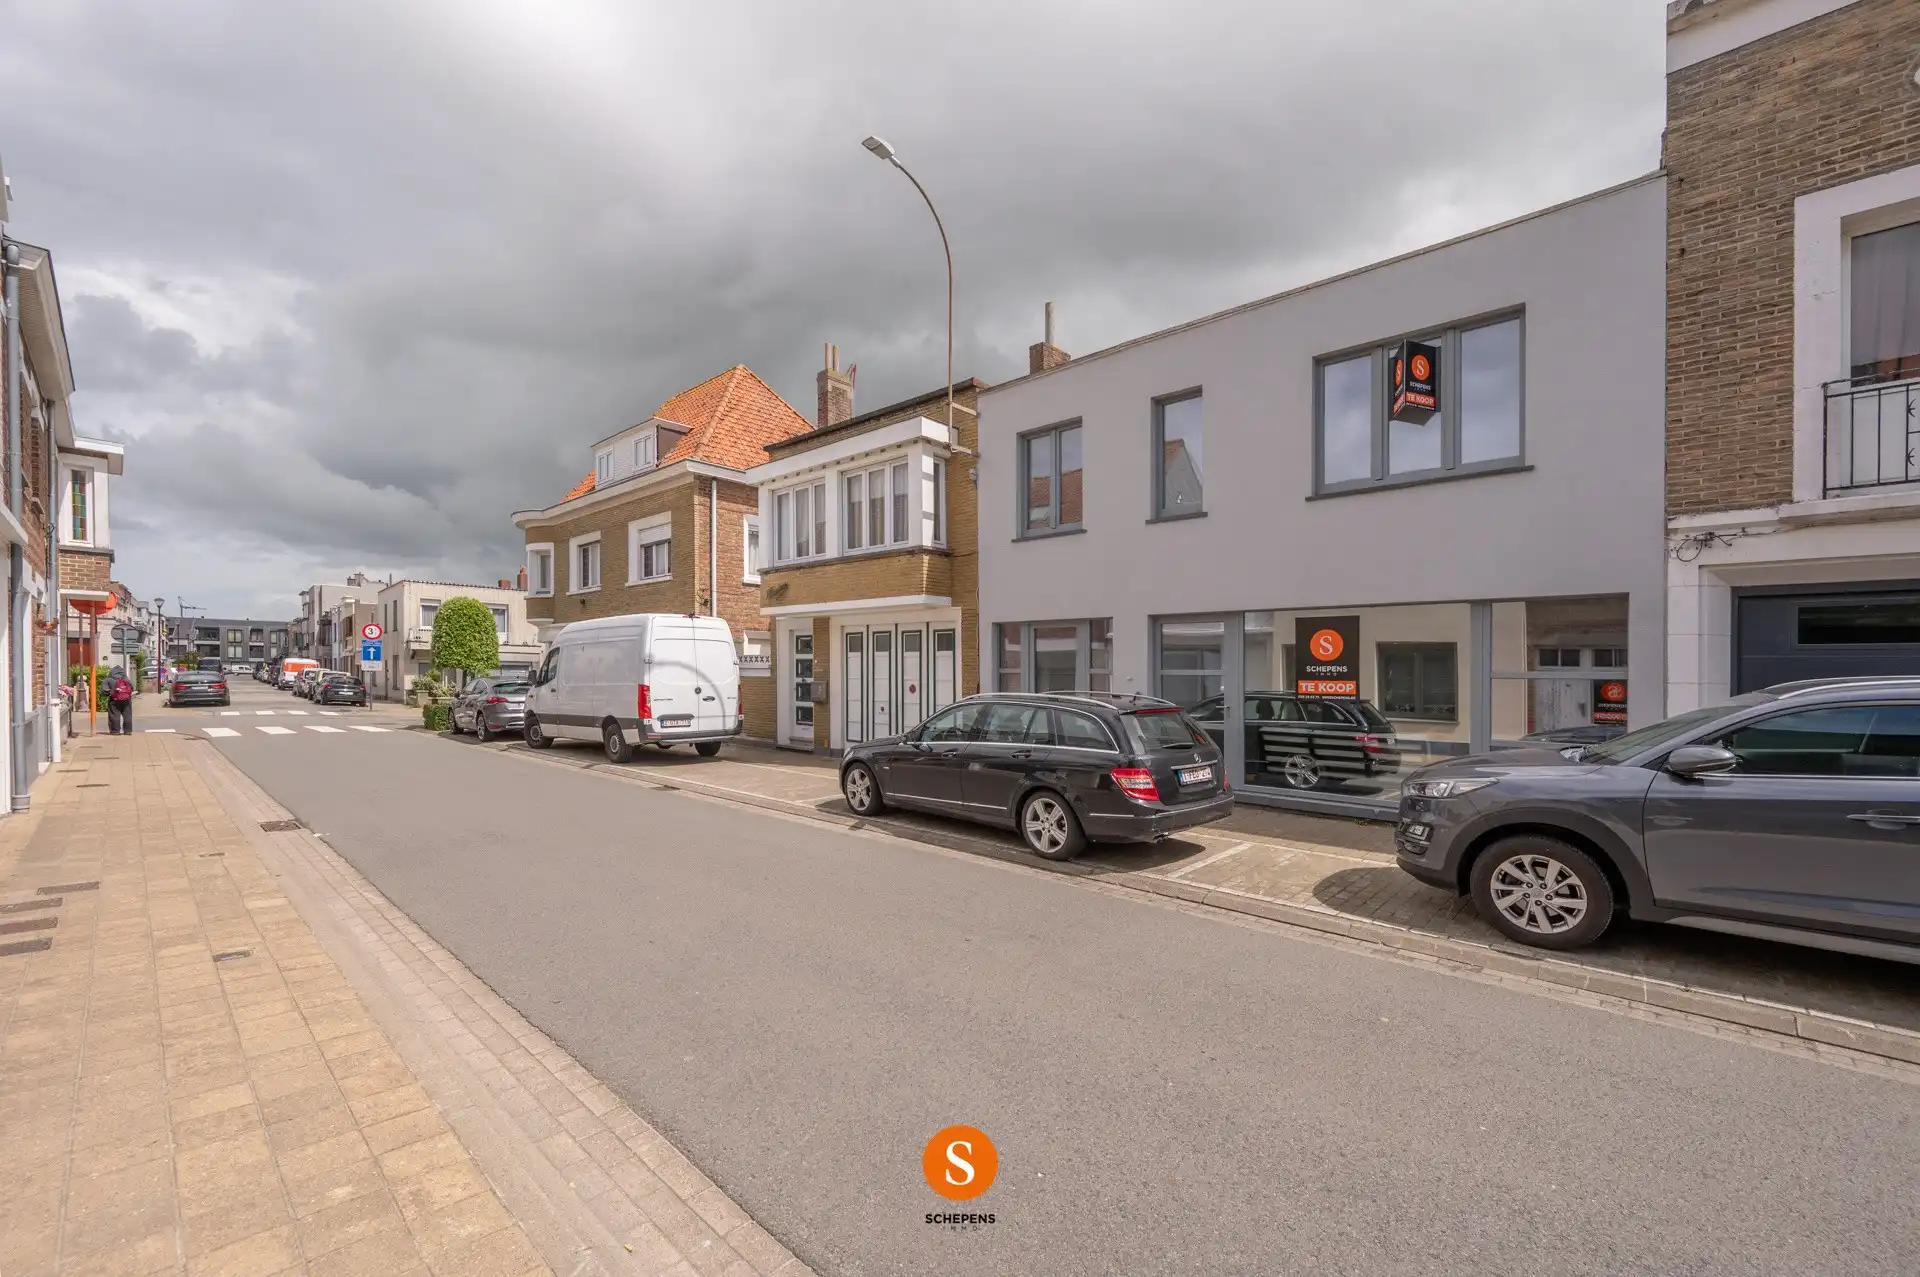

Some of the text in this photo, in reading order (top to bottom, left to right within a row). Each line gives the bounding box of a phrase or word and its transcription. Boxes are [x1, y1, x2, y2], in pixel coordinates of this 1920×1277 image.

[1416, 359, 1425, 376] S
[1407, 393, 1434, 405] TE KOOP
[1319, 635, 1333, 655] S
[1306, 665, 1348, 673] SCHEPENS
[1300, 682, 1354, 693] TE KOOP
